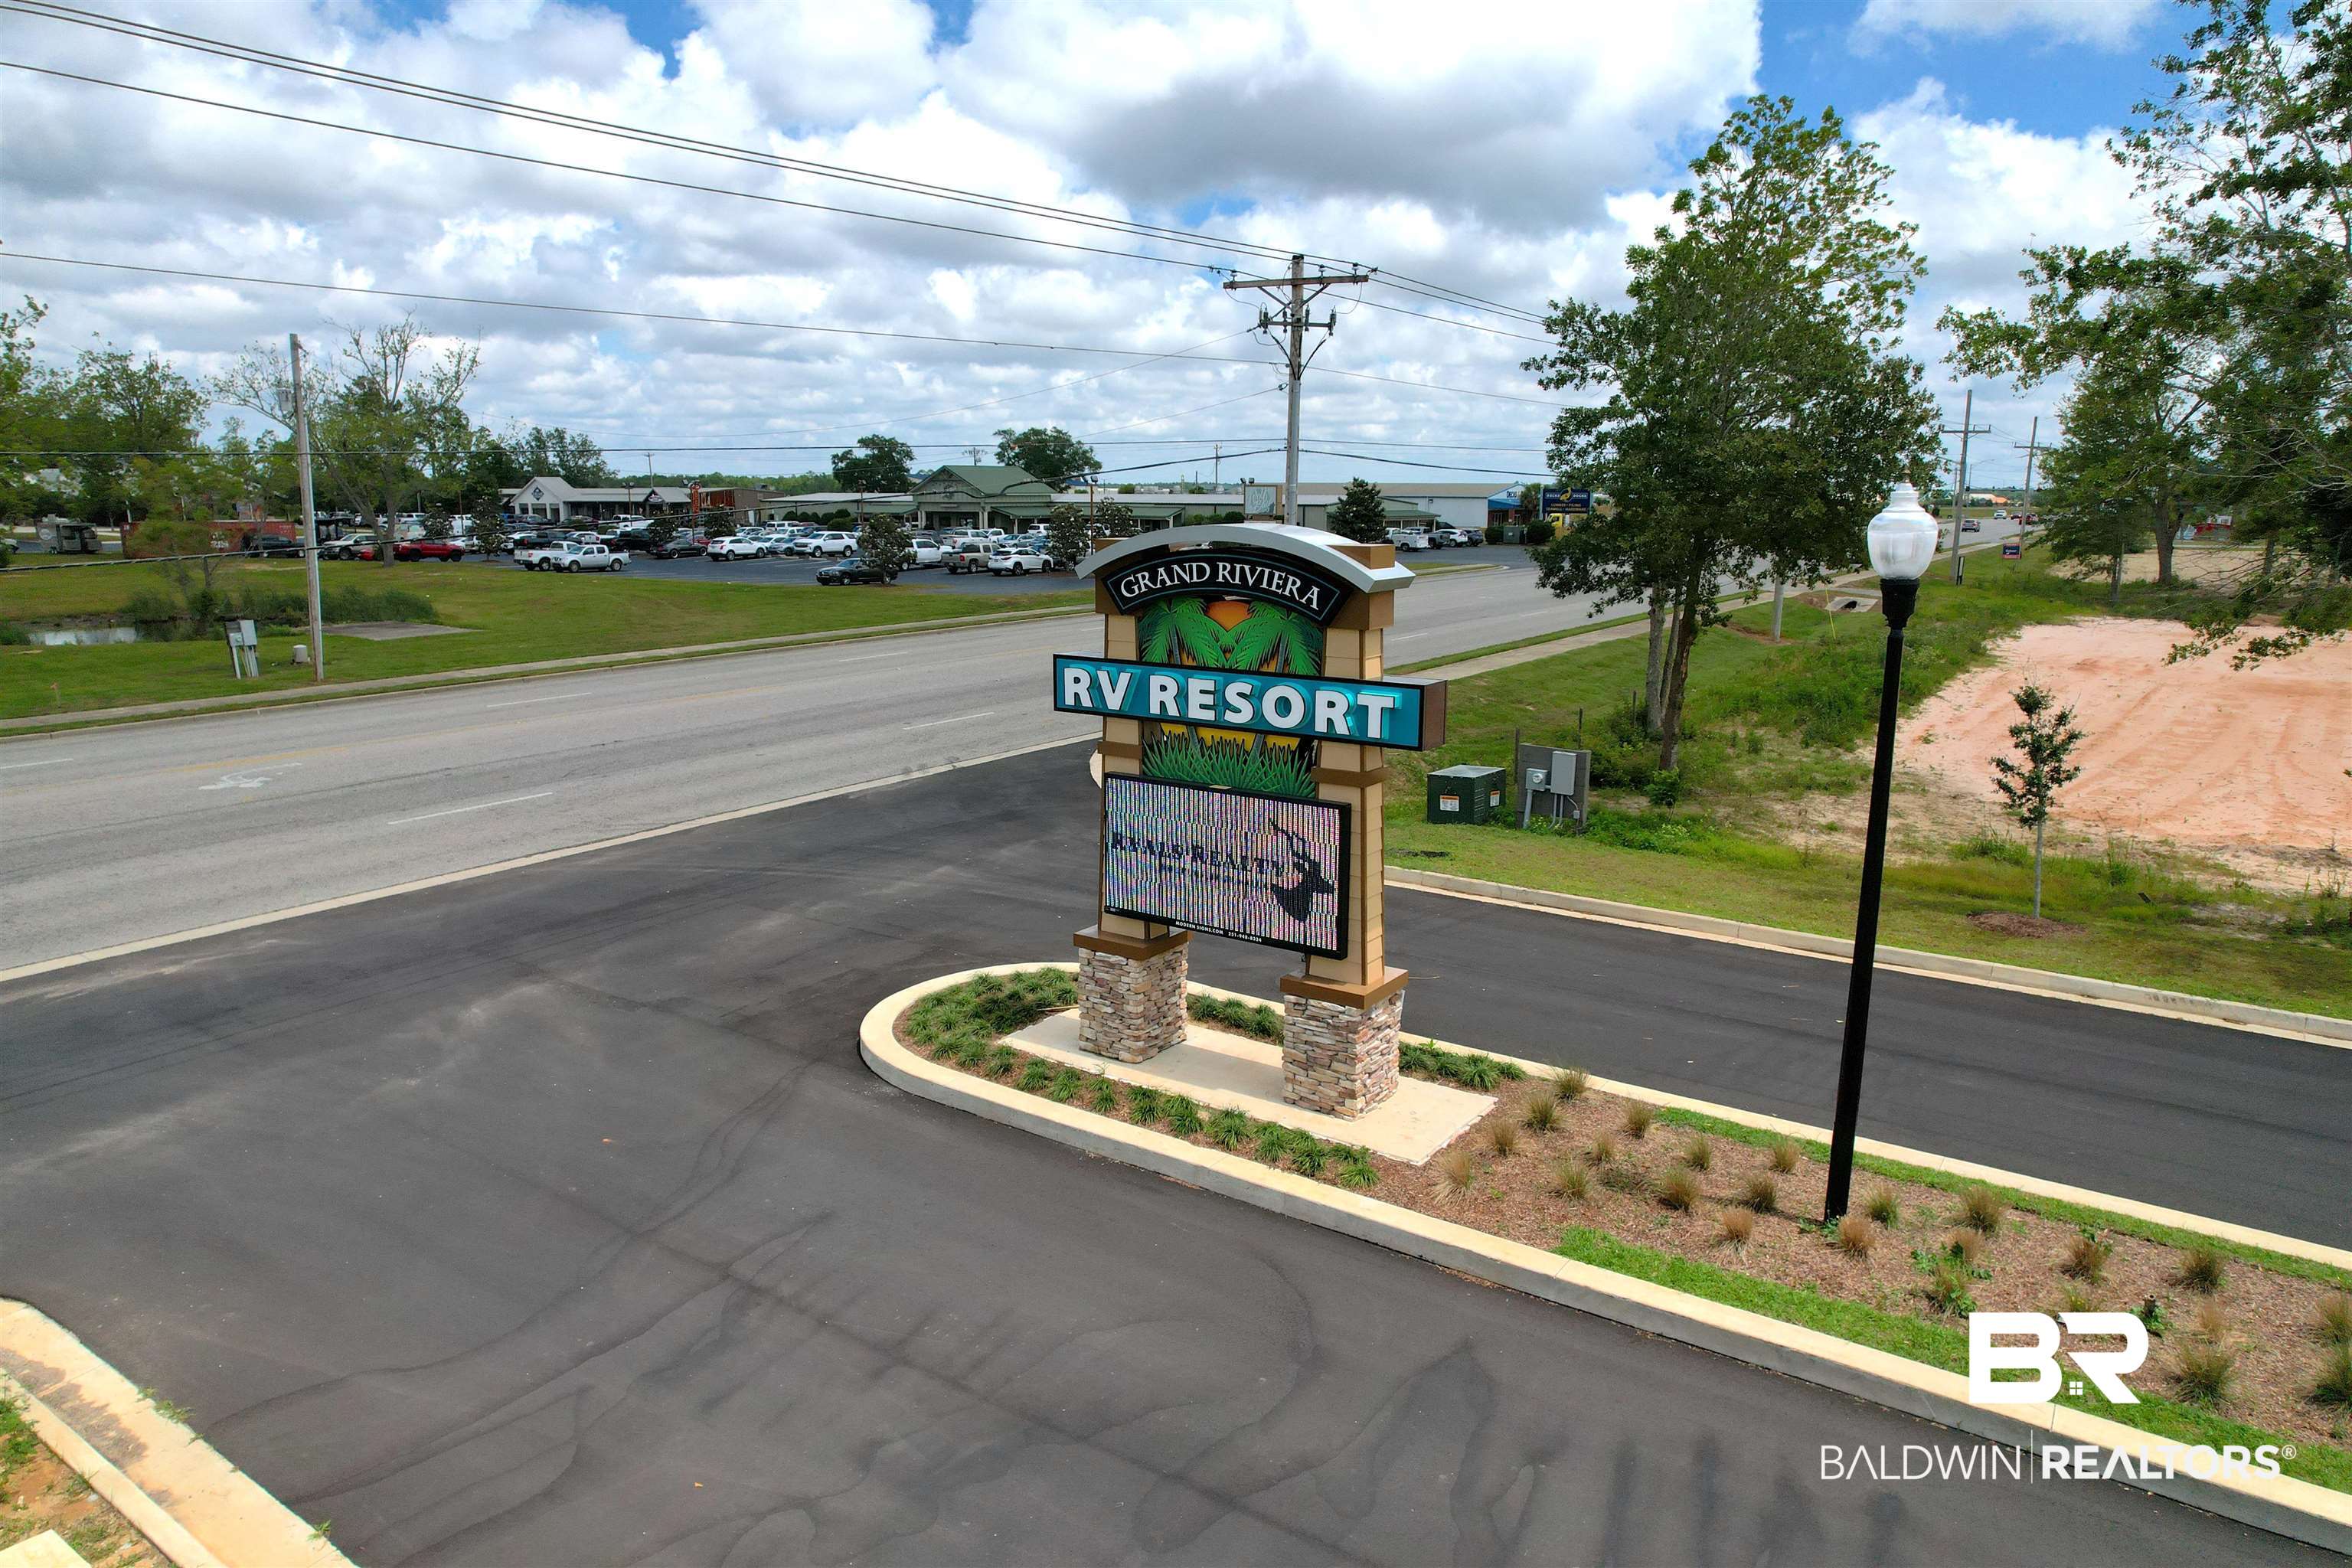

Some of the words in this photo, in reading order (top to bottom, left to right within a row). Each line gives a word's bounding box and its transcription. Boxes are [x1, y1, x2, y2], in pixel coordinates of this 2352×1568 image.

[1120, 562, 1210, 598] GRAND
[1216, 562, 1320, 610] RIVIERA
[1063, 667, 1133, 711] RV
[1148, 674, 1396, 740] RESORT
